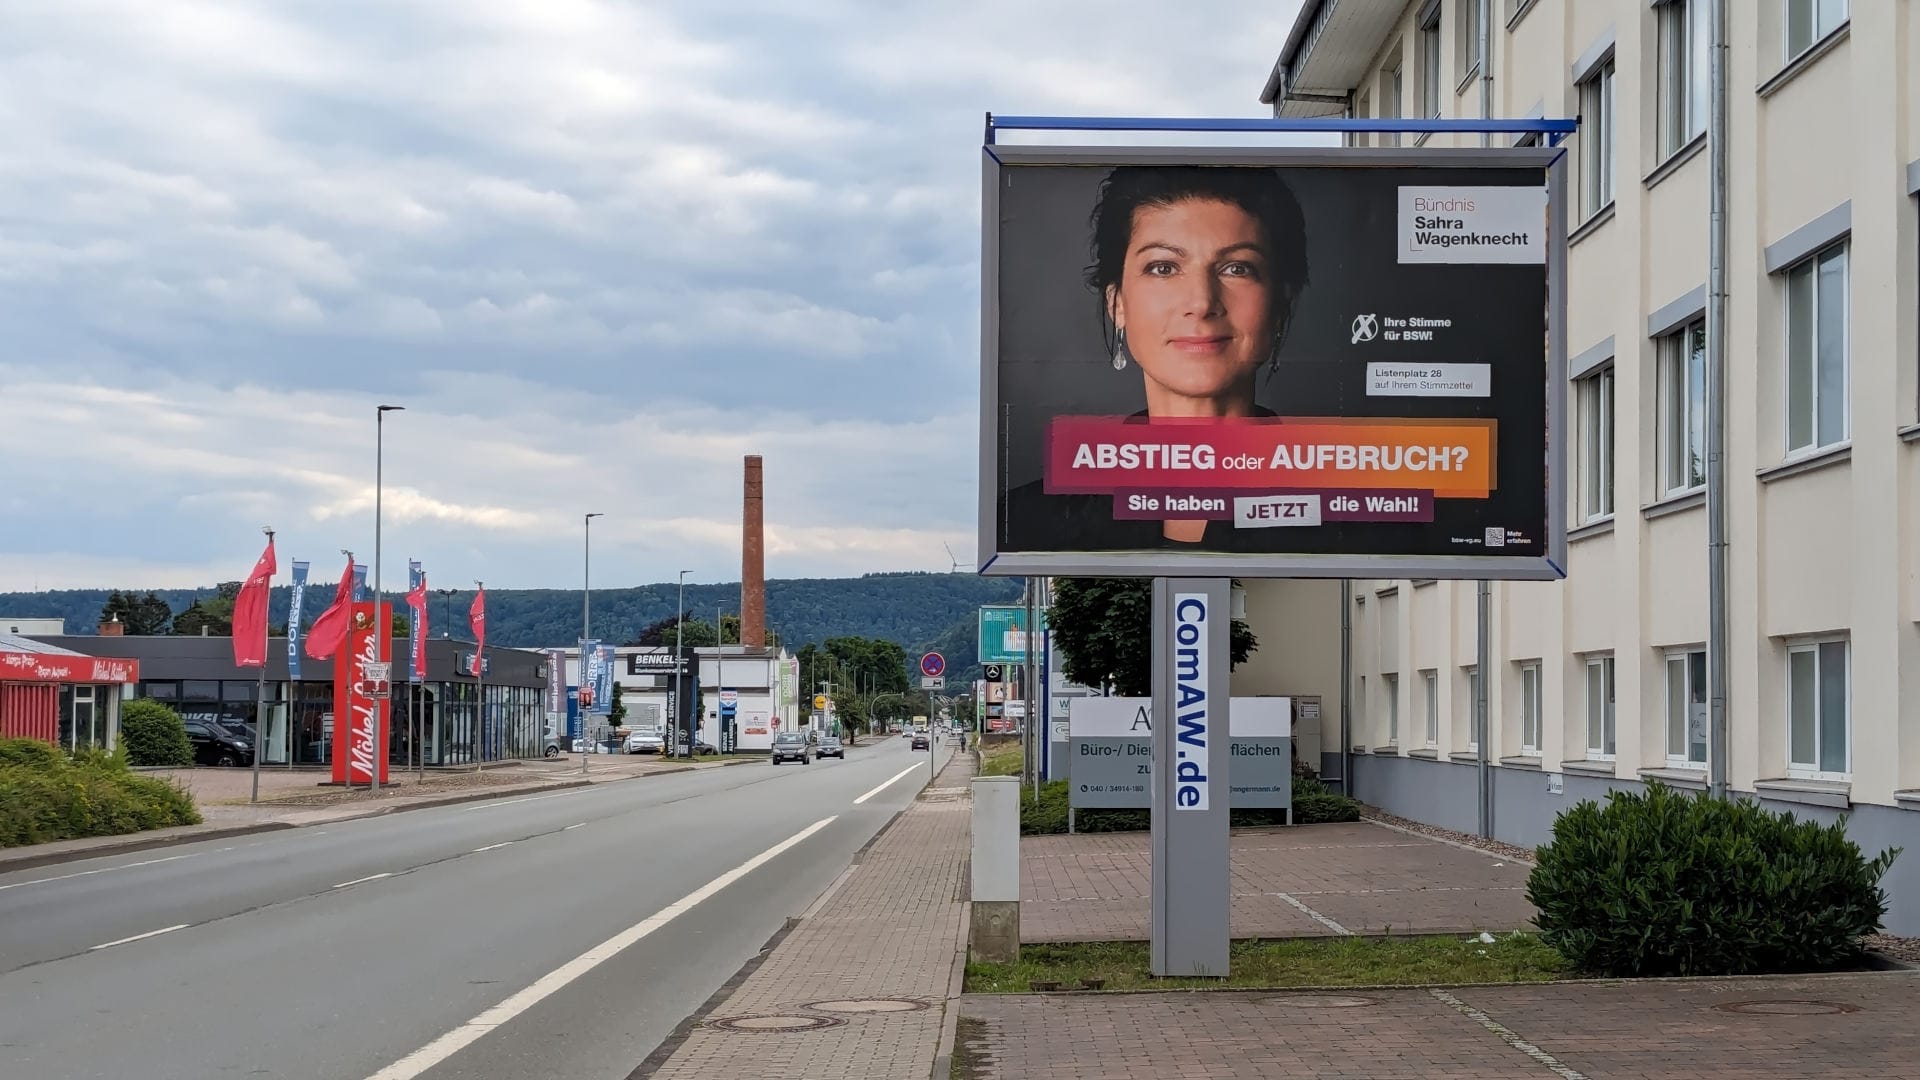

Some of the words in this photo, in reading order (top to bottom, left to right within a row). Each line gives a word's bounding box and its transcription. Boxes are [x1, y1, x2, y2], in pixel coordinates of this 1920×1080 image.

[1414, 197, 1475, 212] Bündnis
[1415, 216, 1464, 229] Sahra
[1415, 232, 1528, 247] Wagenknecht
[1384, 317, 1406, 327] Ihre
[1409, 317, 1451, 327] Stimme
[1384, 331, 1401, 341] für
[1403, 331, 1433, 341] BSW!
[1375, 369, 1428, 379] Listenplatz
[1430, 369, 1442, 378] 28
[1375, 381, 1389, 389] auf
[1392, 381, 1417, 389] Ihrem
[1420, 381, 1473, 390] Stimmzettel
[1072, 443, 1216, 470] ABSTIEG
[1221, 451, 1265, 471] oder
[1269, 444, 1469, 472] AUFBRUCH?
[1128, 494, 1159, 511] Sie
[1165, 495, 1225, 512] haben
[1246, 502, 1308, 520] JETZT
[1329, 495, 1360, 512] die
[1365, 495, 1419, 513] Wahl!
[635, 655, 675, 664] BENKEL
[1176, 598, 1207, 807] ComAW.de
